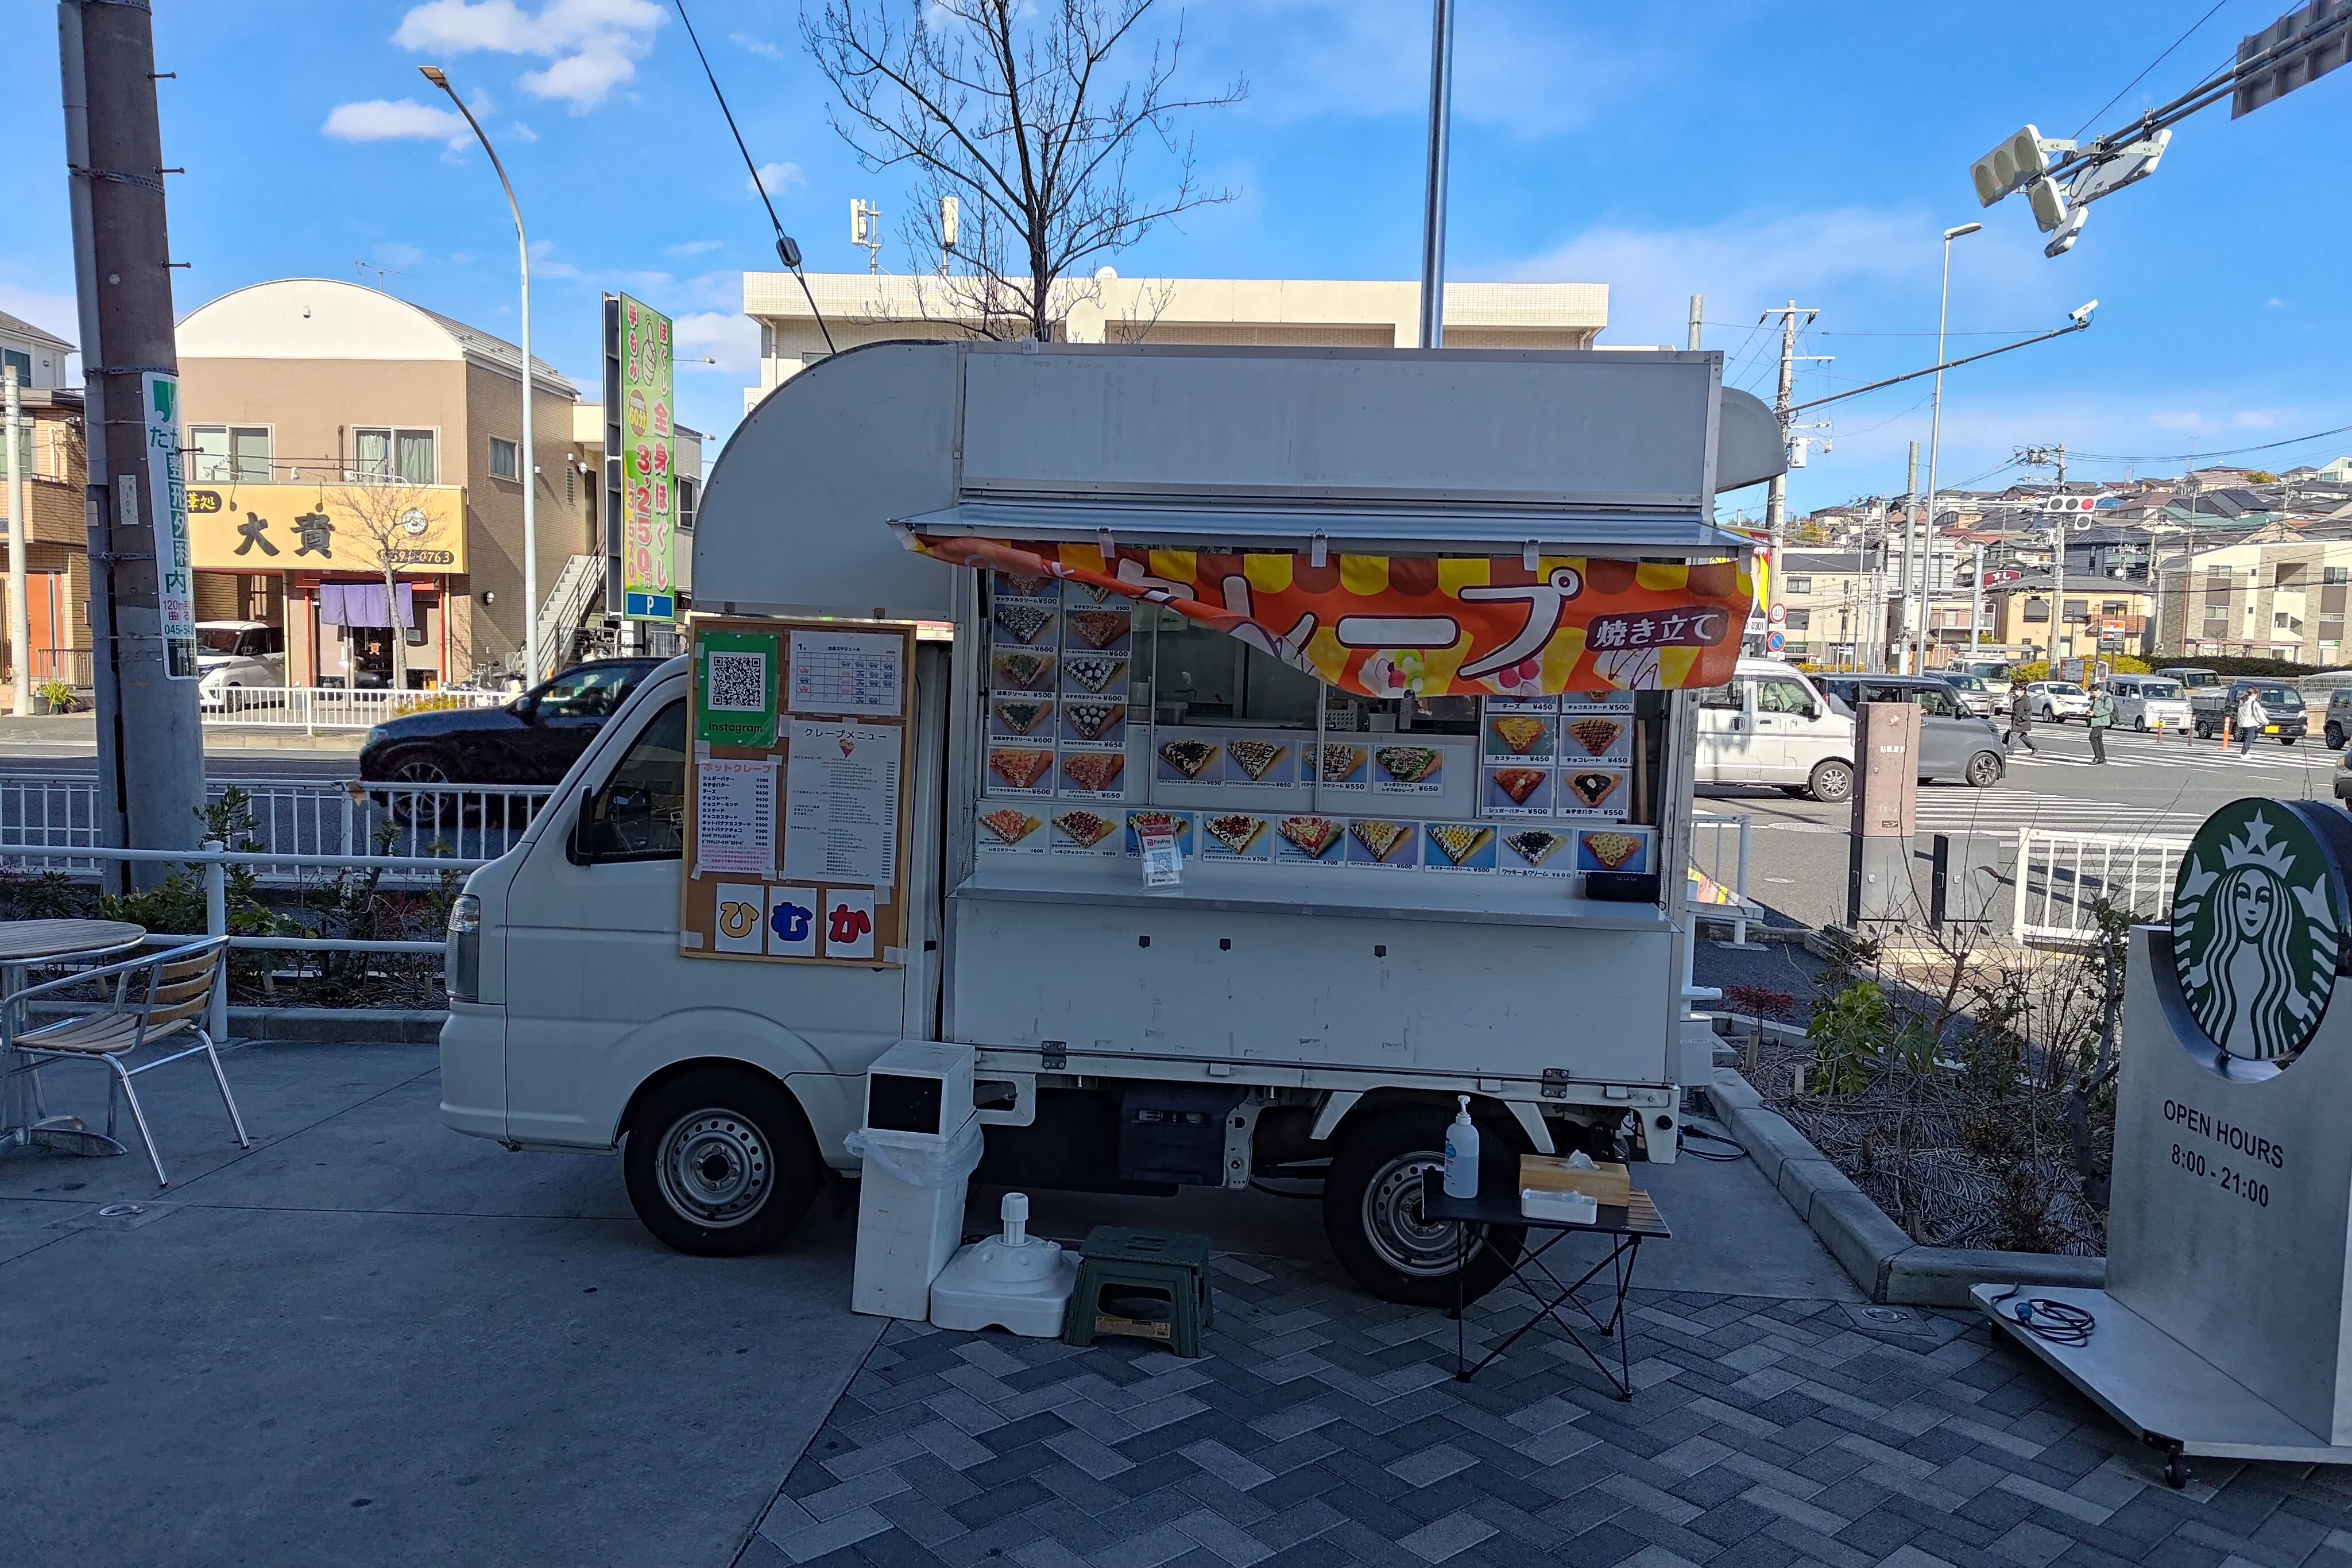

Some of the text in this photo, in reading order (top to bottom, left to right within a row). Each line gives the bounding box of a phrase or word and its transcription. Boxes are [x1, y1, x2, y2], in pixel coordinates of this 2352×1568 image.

[647, 595, 654, 614] P
[1593, 613, 1720, 648] 焼き立て
[805, 728, 887, 740] クレープメニュー
[704, 763, 772, 773] ホットクレープ
[2163, 1099, 2284, 1169] OPEN HOURS
[2171, 1143, 2206, 1178] 8:00
[2221, 1166, 2269, 1208] 21:00
